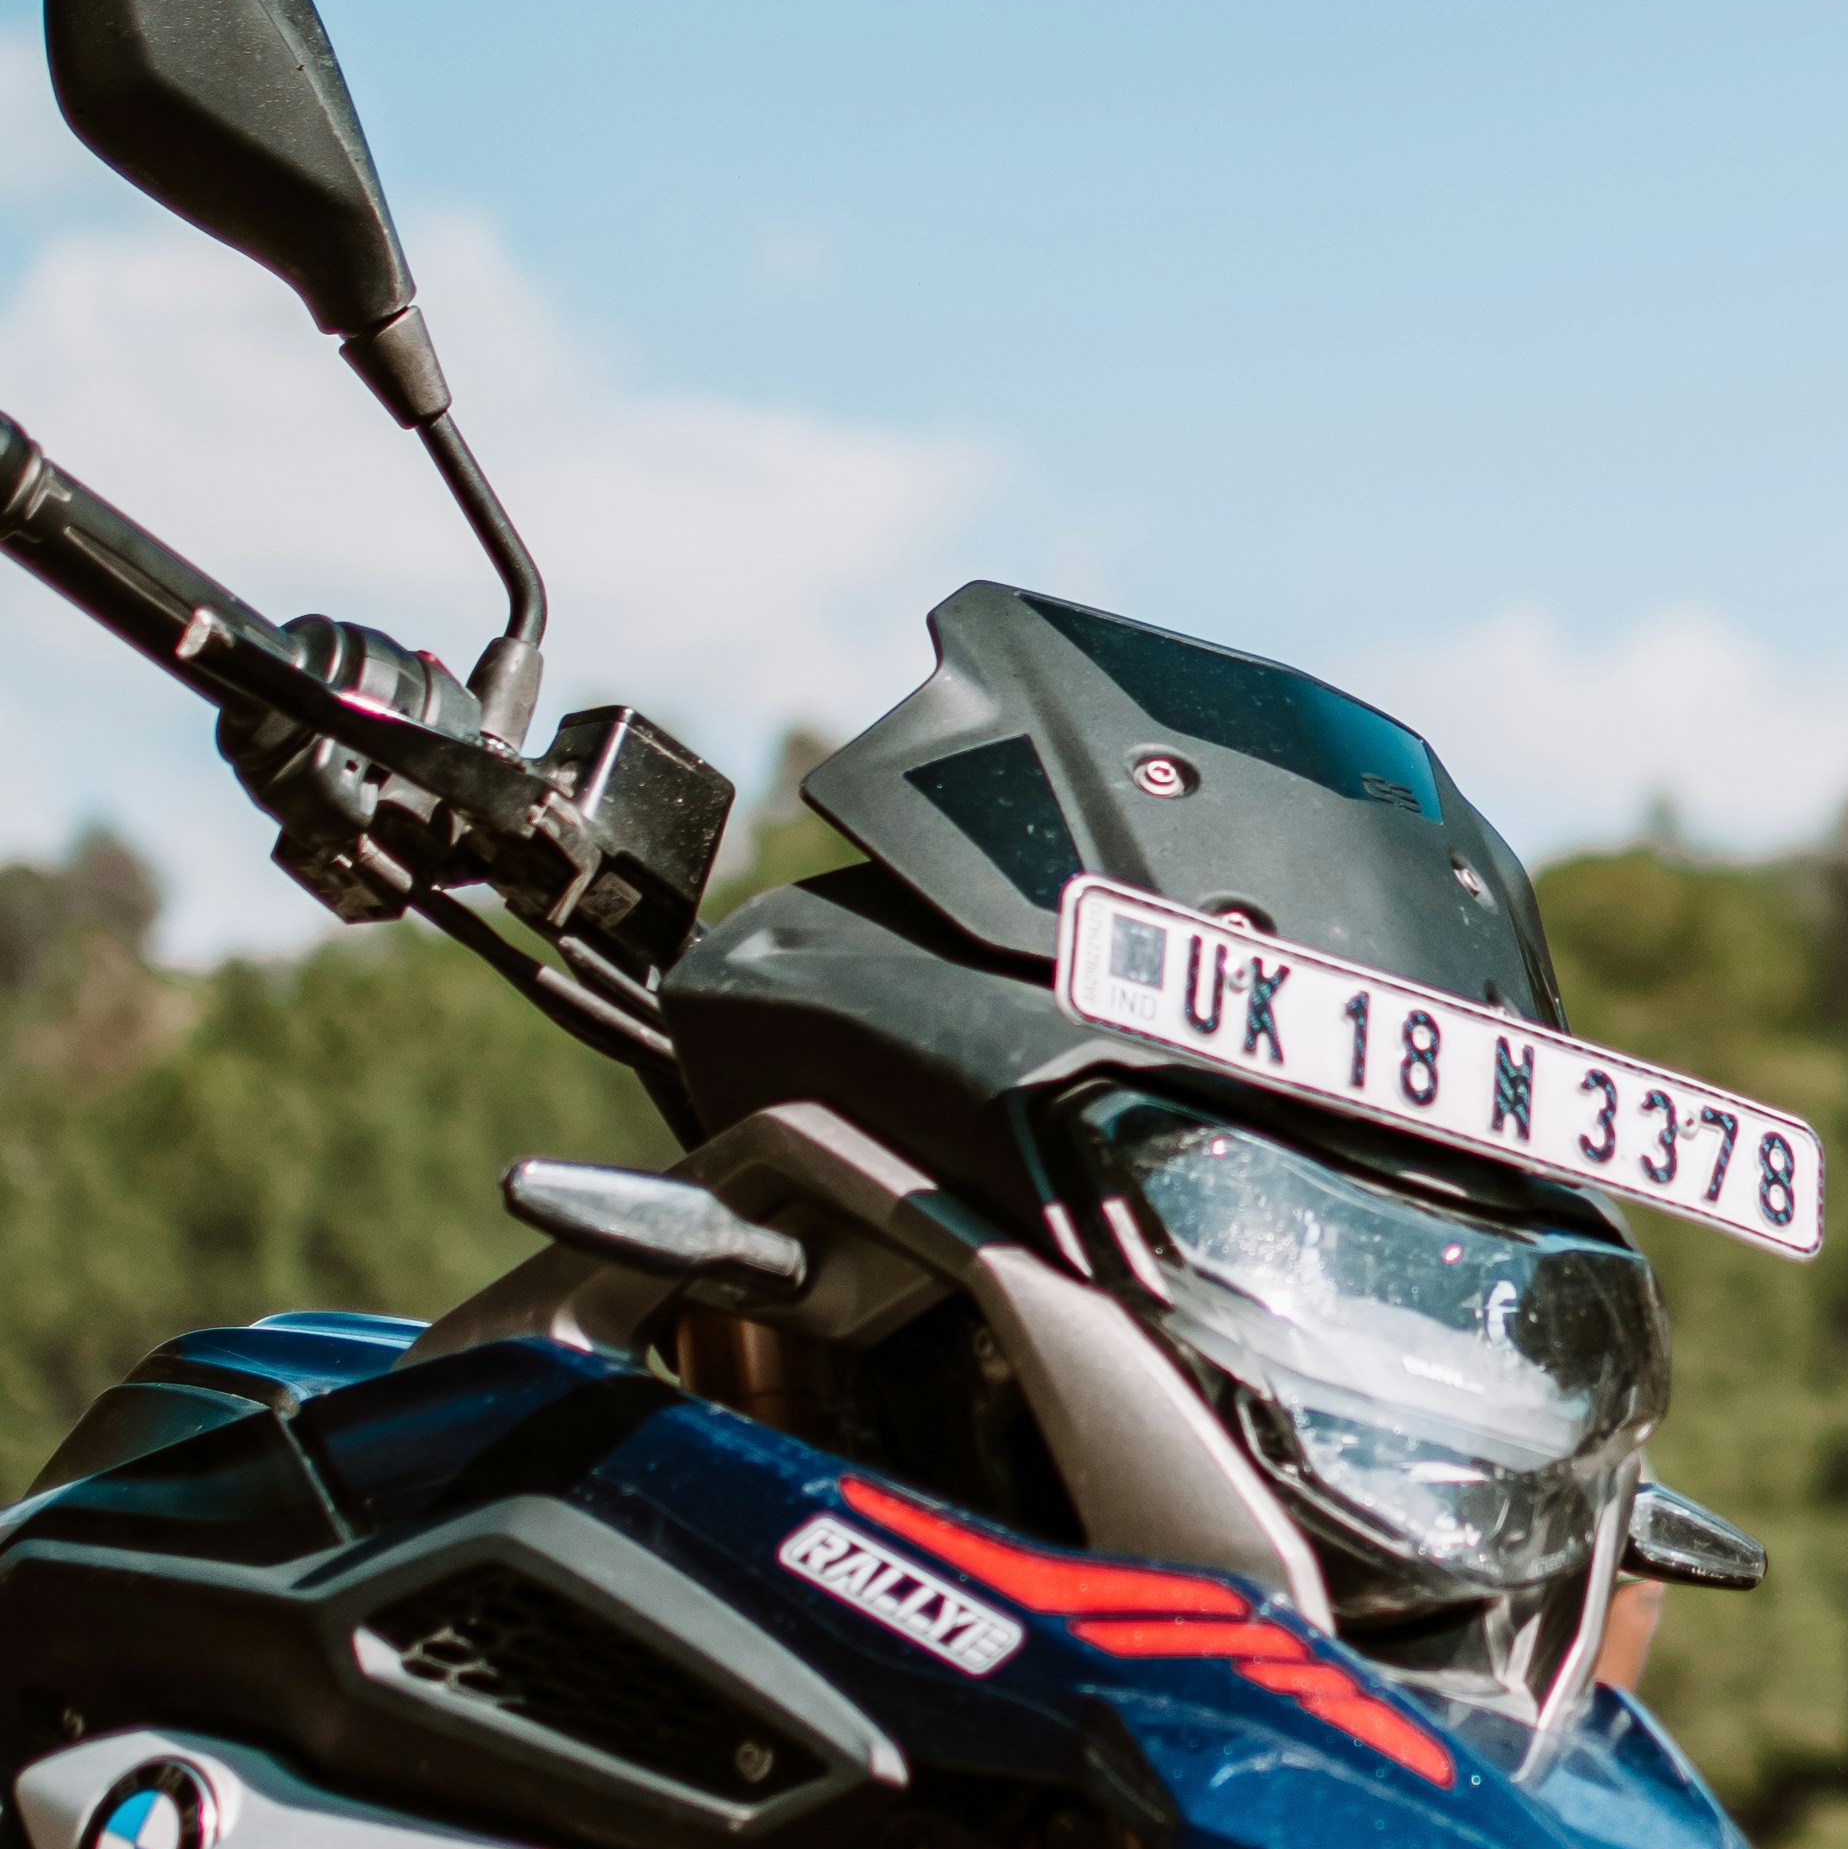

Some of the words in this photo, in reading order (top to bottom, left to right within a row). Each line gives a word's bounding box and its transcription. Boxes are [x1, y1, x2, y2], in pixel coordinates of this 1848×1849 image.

[1110, 983, 1159, 1022] IND
[1184, 932, 1291, 1066] UK
[1344, 989, 1442, 1107] 18
[1489, 1034, 1536, 1141] N
[1578, 1069, 1797, 1227] 3378
[790, 1526, 1011, 1664] RALLYE
